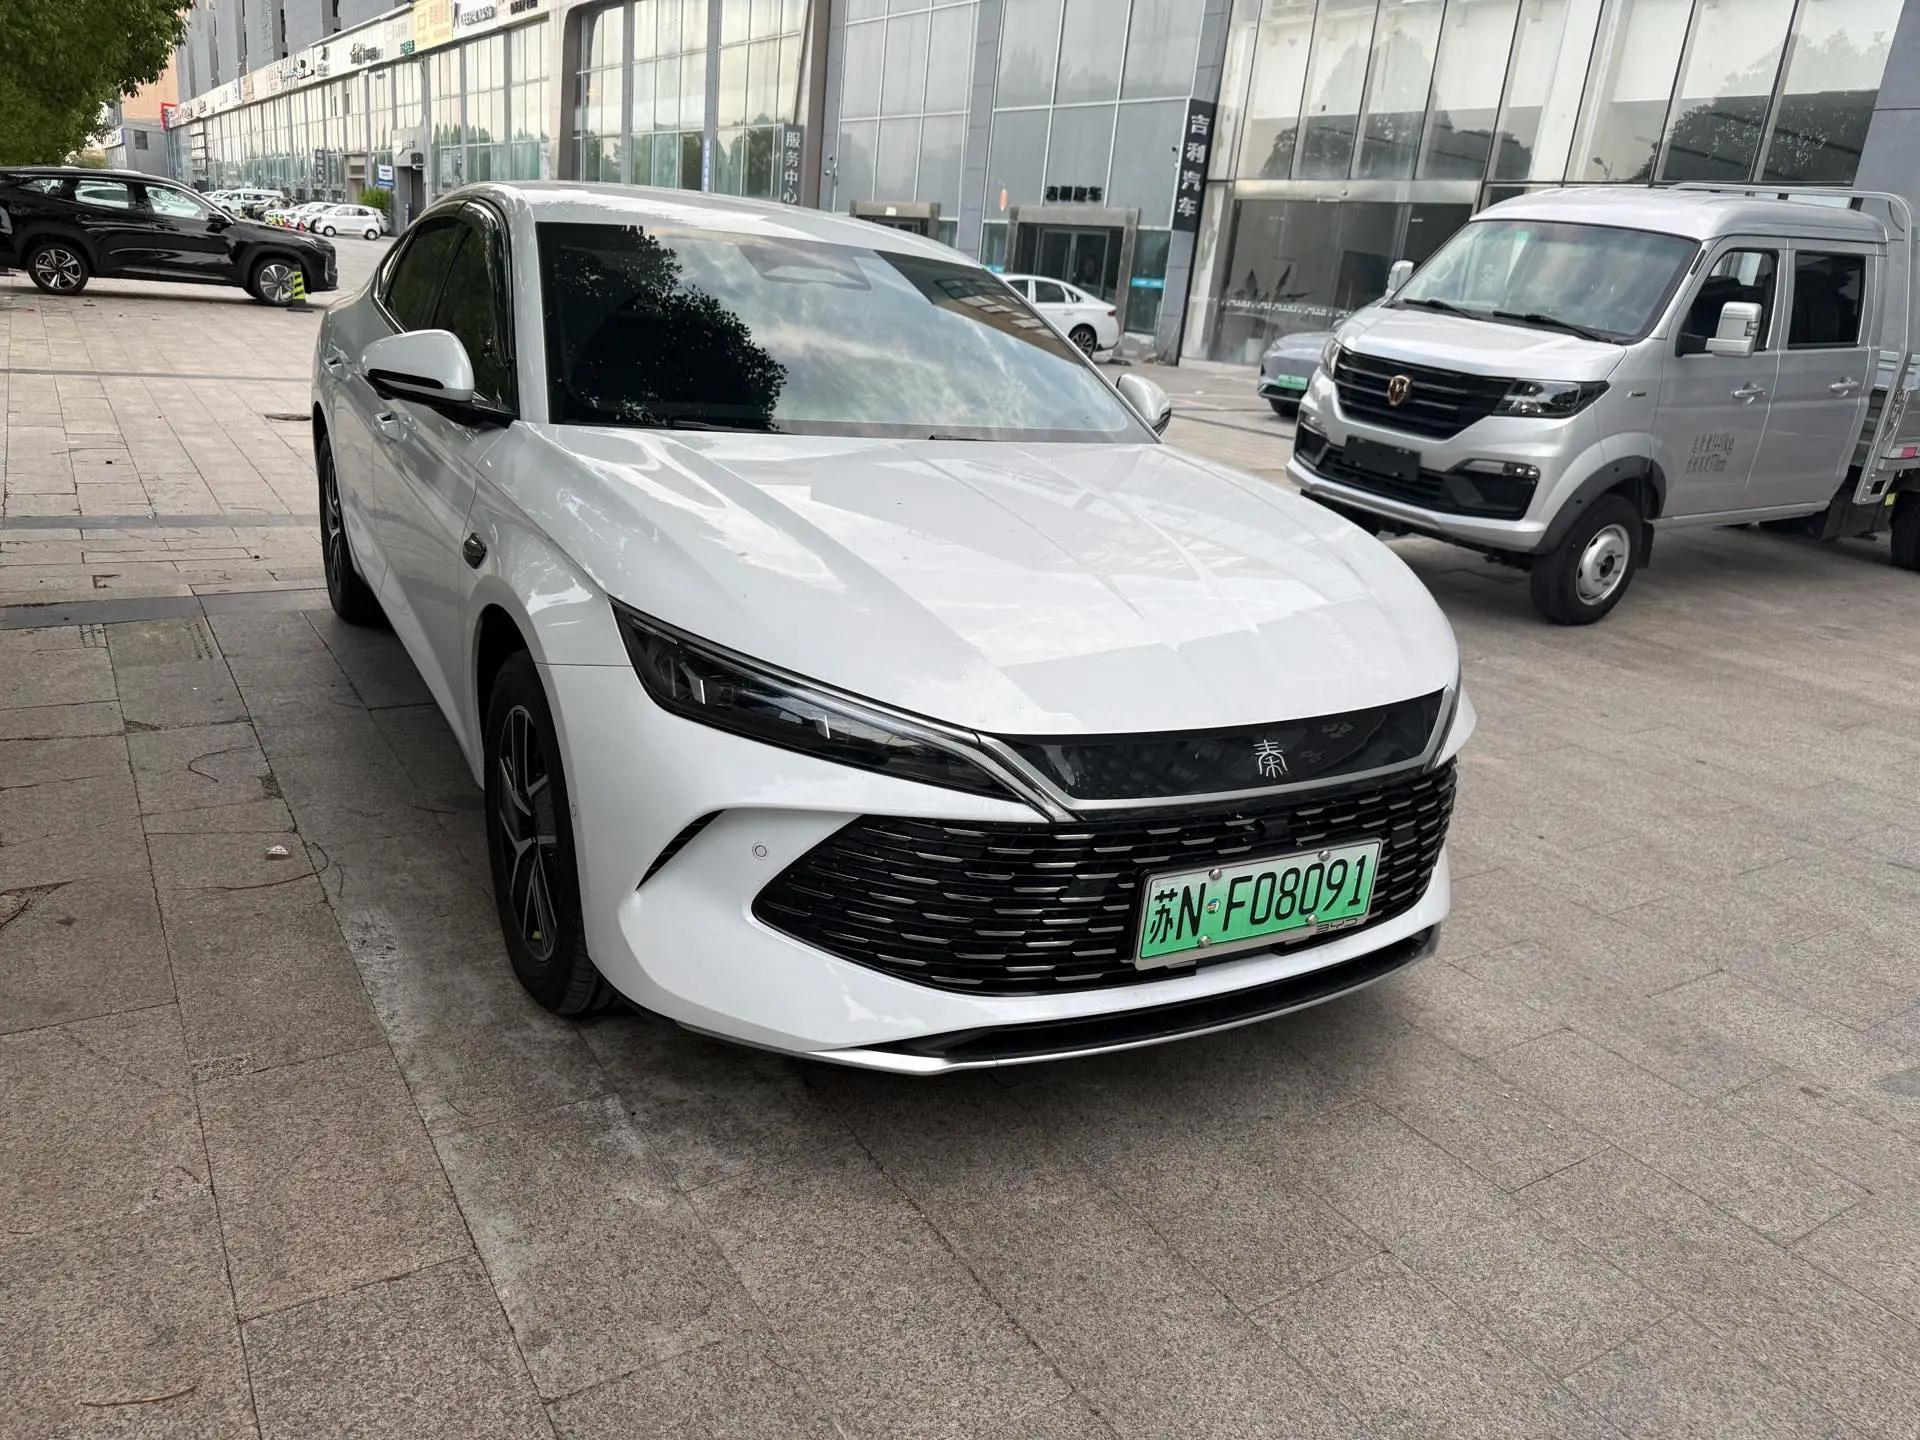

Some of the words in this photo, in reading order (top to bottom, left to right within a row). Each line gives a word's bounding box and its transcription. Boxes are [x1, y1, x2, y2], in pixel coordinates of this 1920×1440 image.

[783, 131, 801, 203] 服务中心
[1177, 114, 1210, 217] 吉利汽车
[1253, 739, 1289, 779] 秦
[1316, 918, 1358, 933] BYD
